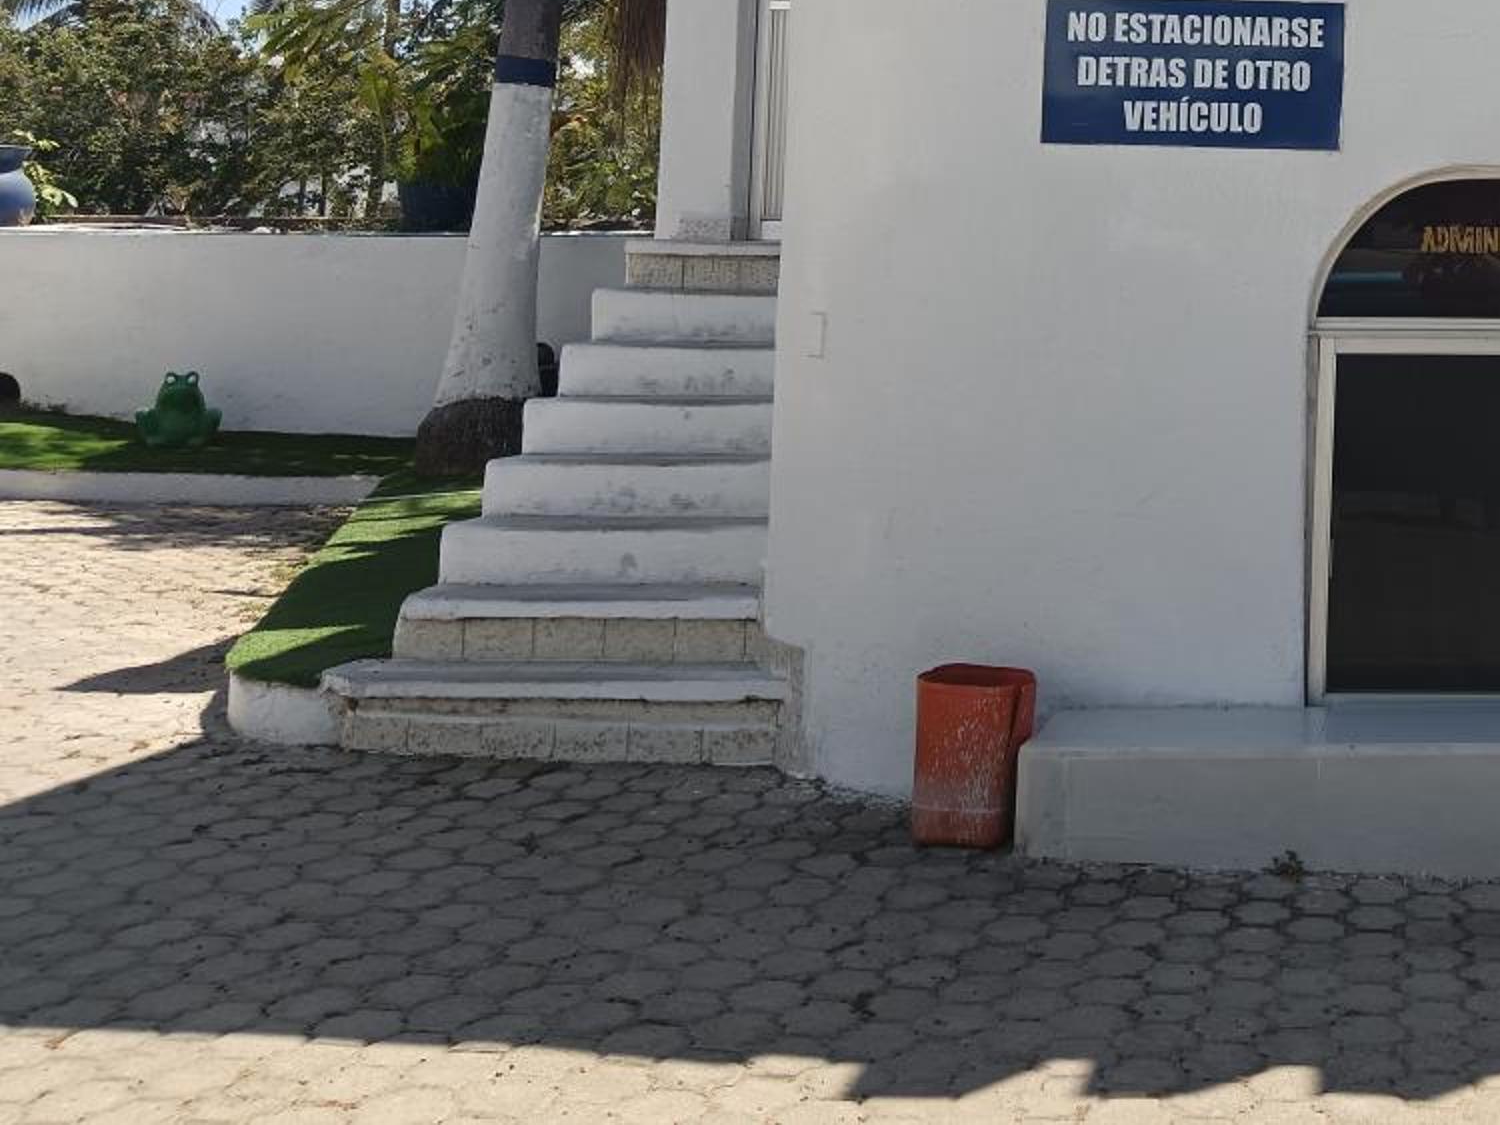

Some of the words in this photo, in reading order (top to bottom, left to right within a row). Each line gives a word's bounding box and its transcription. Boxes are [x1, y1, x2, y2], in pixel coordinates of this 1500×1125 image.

[1067, 11, 1107, 42] NO
[1114, 13, 1325, 48] ESTACIONARSE
[1077, 56, 1187, 88] DETRAS
[1193, 58, 1229, 90] DE
[1235, 60, 1312, 92] OTRO
[1123, 96, 1263, 134] VEHÍCULO
